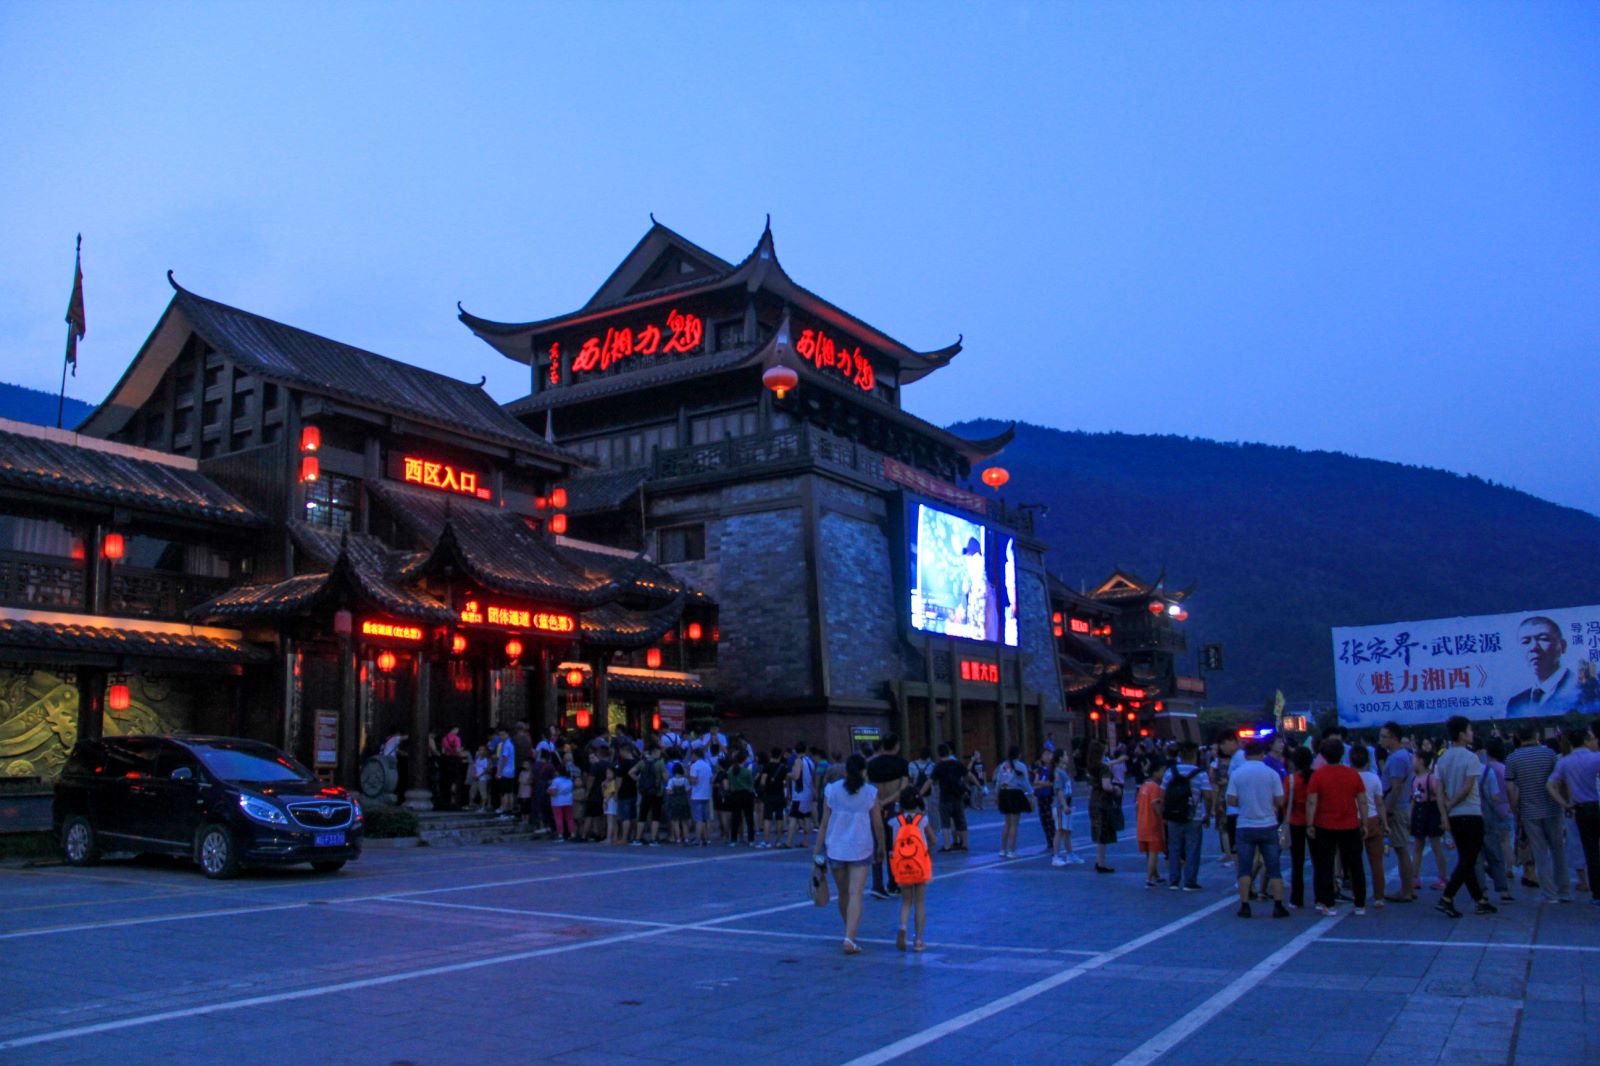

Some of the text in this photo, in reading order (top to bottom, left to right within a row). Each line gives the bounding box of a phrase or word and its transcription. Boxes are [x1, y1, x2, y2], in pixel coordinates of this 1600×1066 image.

[404, 457, 475, 493] 西区入口
[1571, 622, 1583, 645] 导演
[1355, 664, 1488, 695] 《魅力湘西》
